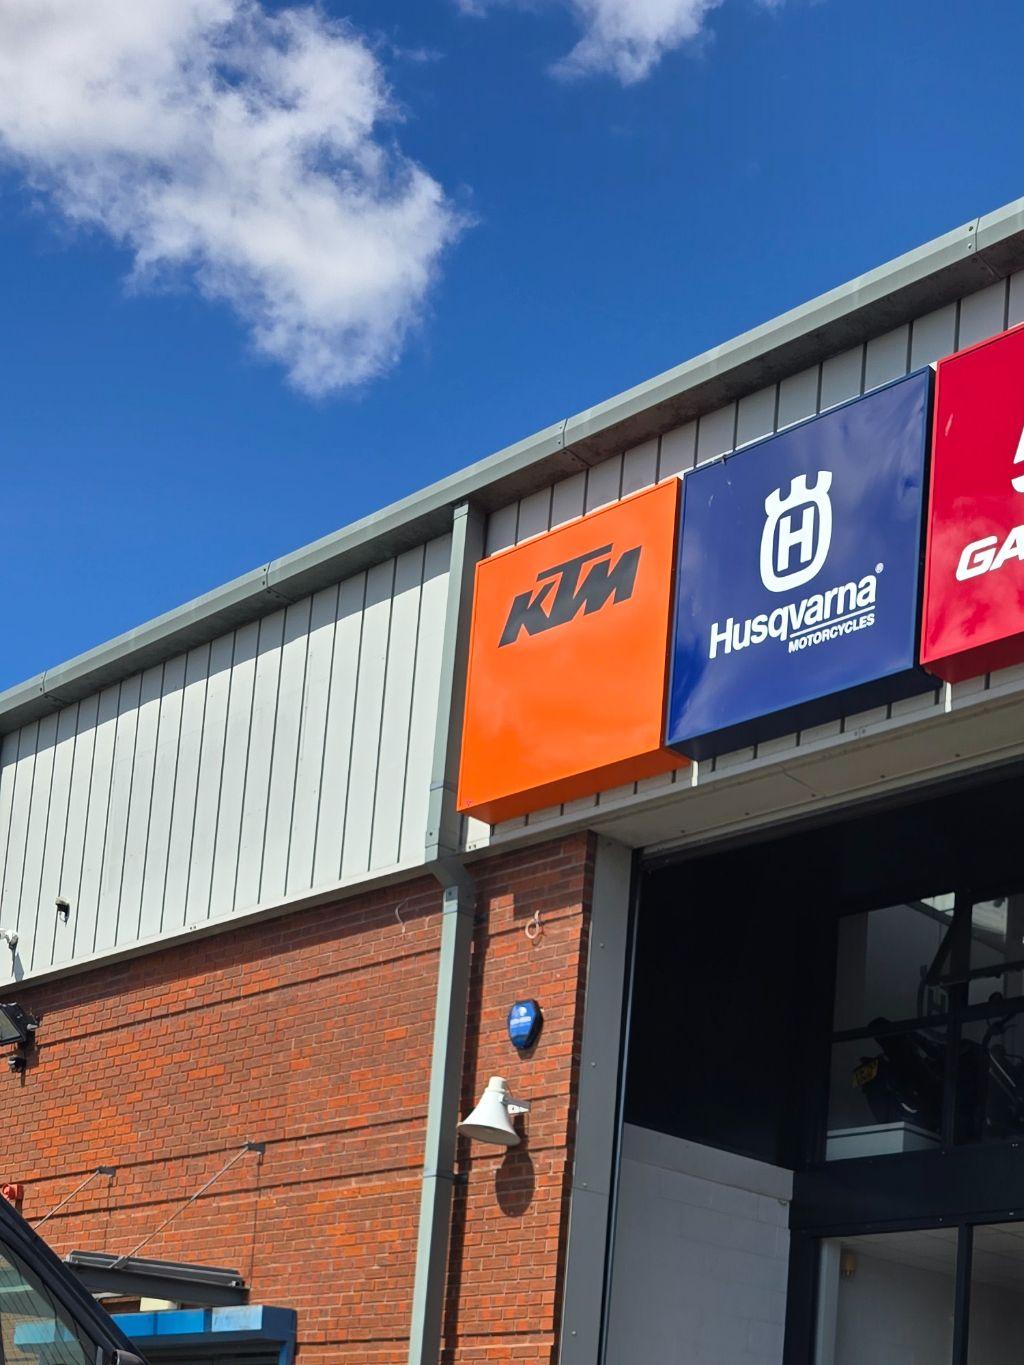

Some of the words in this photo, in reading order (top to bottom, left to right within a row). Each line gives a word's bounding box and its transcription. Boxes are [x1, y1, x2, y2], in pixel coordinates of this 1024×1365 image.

[497, 542, 643, 649] KTM
[708, 574, 878, 660] Husqvarna
[788, 612, 876, 654] MOTORCYCLES
